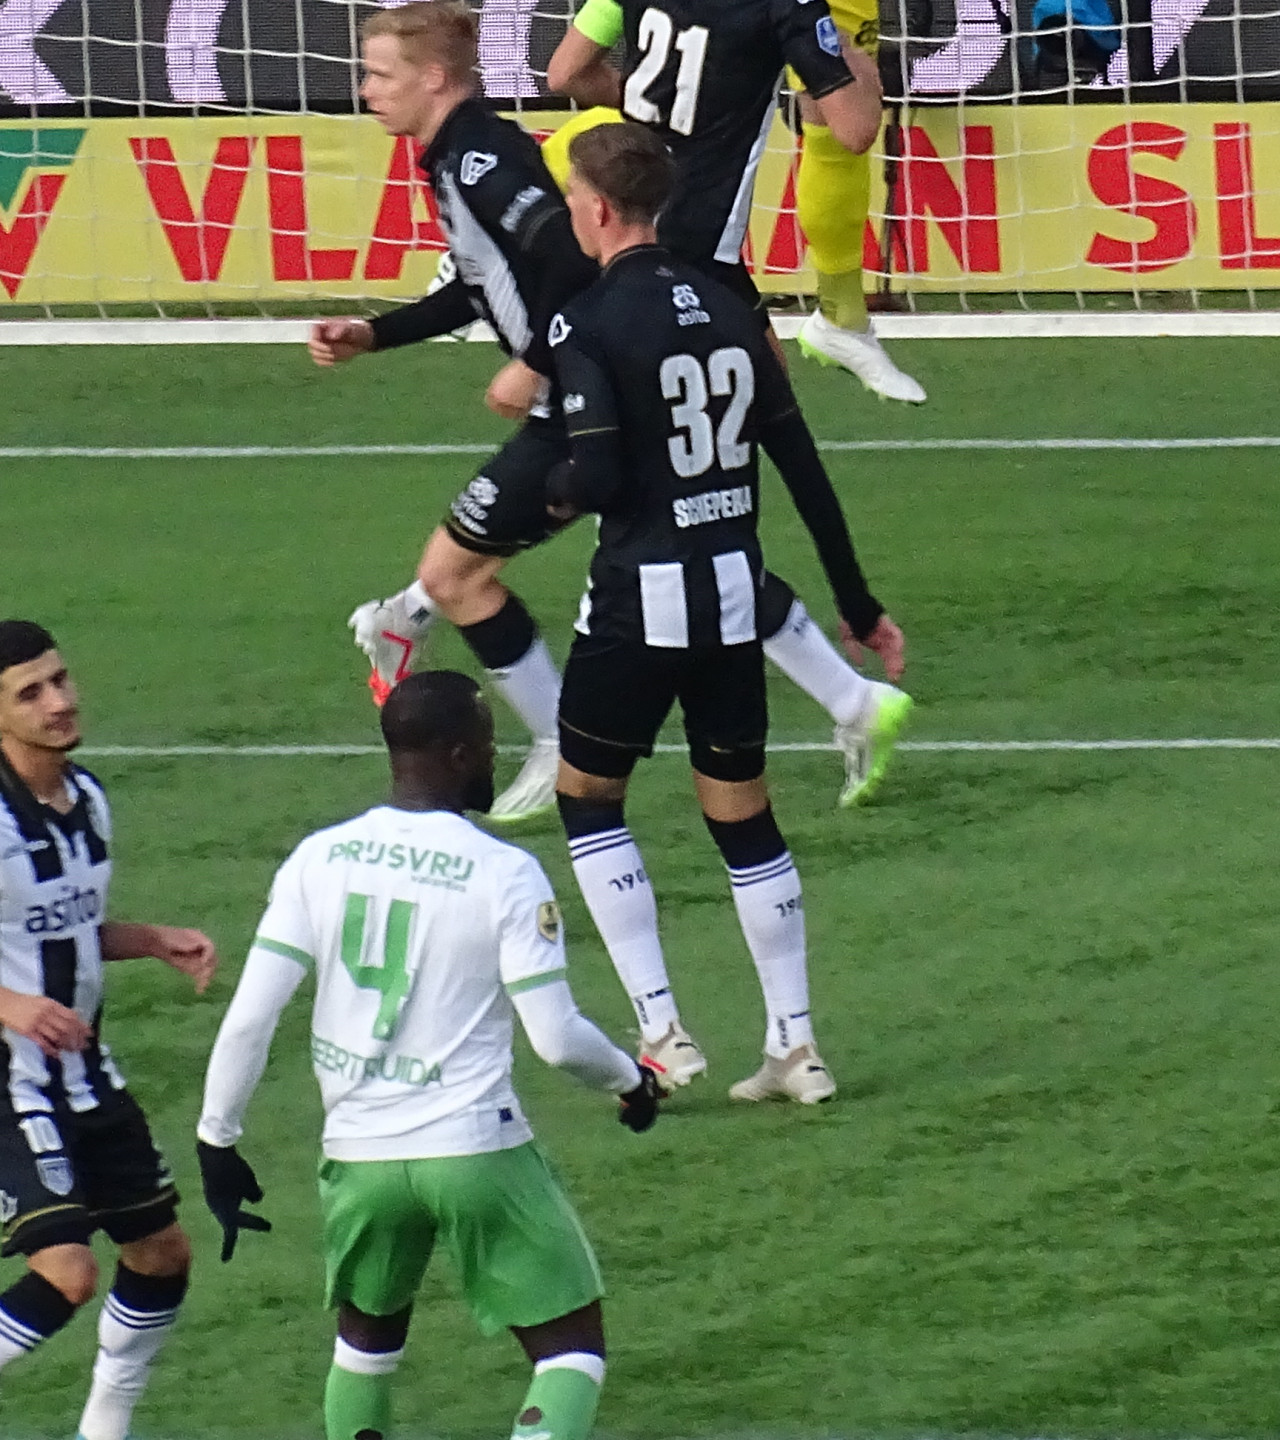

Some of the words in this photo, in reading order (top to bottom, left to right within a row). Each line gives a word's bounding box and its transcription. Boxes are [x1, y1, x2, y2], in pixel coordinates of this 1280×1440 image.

[623, 6, 710, 137] 21
[659, 345, 755, 479] 32
[24, 885, 102, 935] asito
[608, 871, 650, 893] 190
[340, 891, 416, 1042] 4
